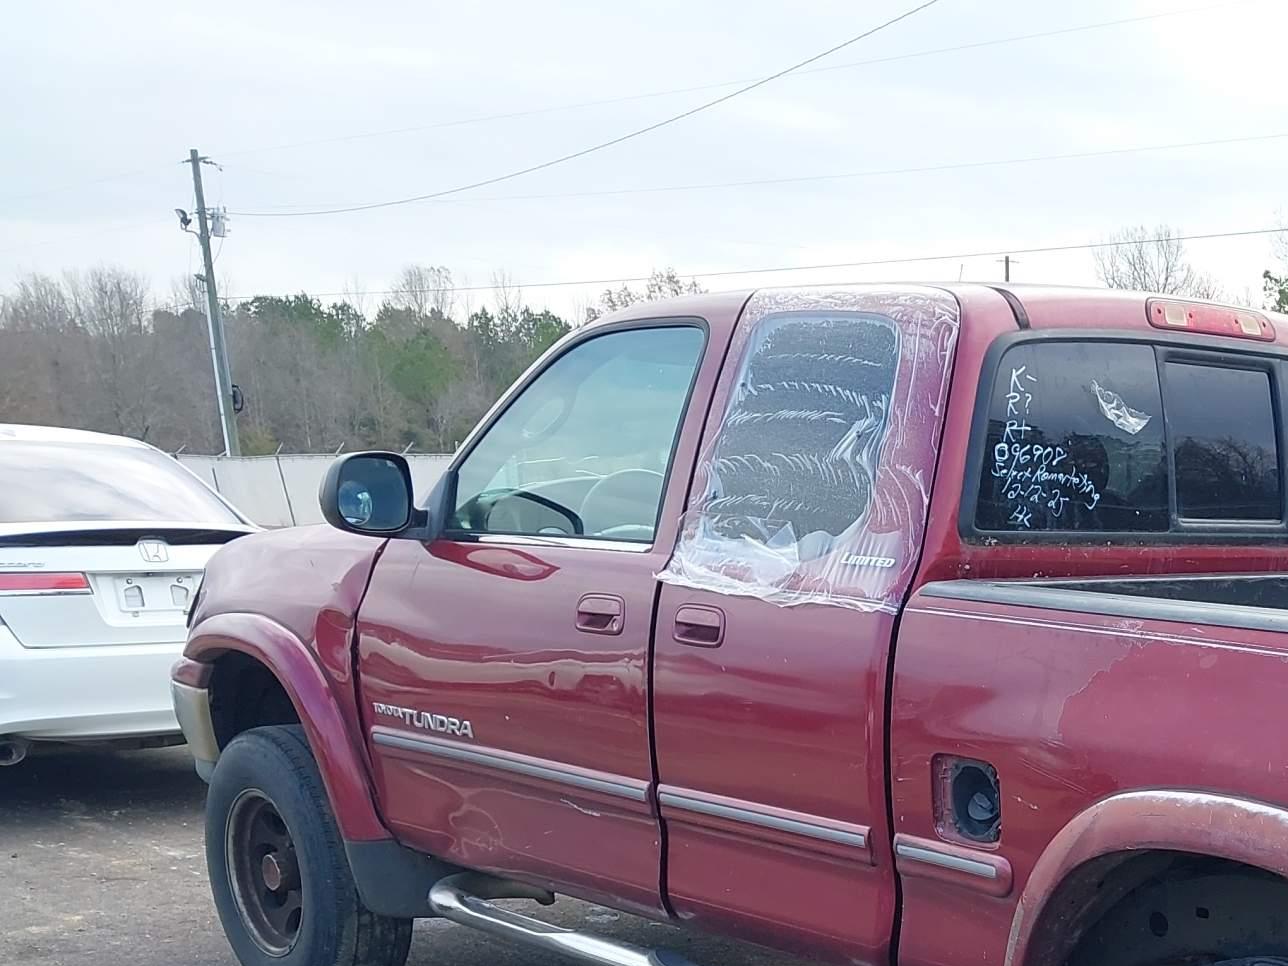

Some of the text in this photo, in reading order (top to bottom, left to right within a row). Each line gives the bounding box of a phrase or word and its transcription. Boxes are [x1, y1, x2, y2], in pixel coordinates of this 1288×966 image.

[840, 553, 897, 568] LIMITED
[372, 702, 474, 739] TOYOTA TUNDRA
